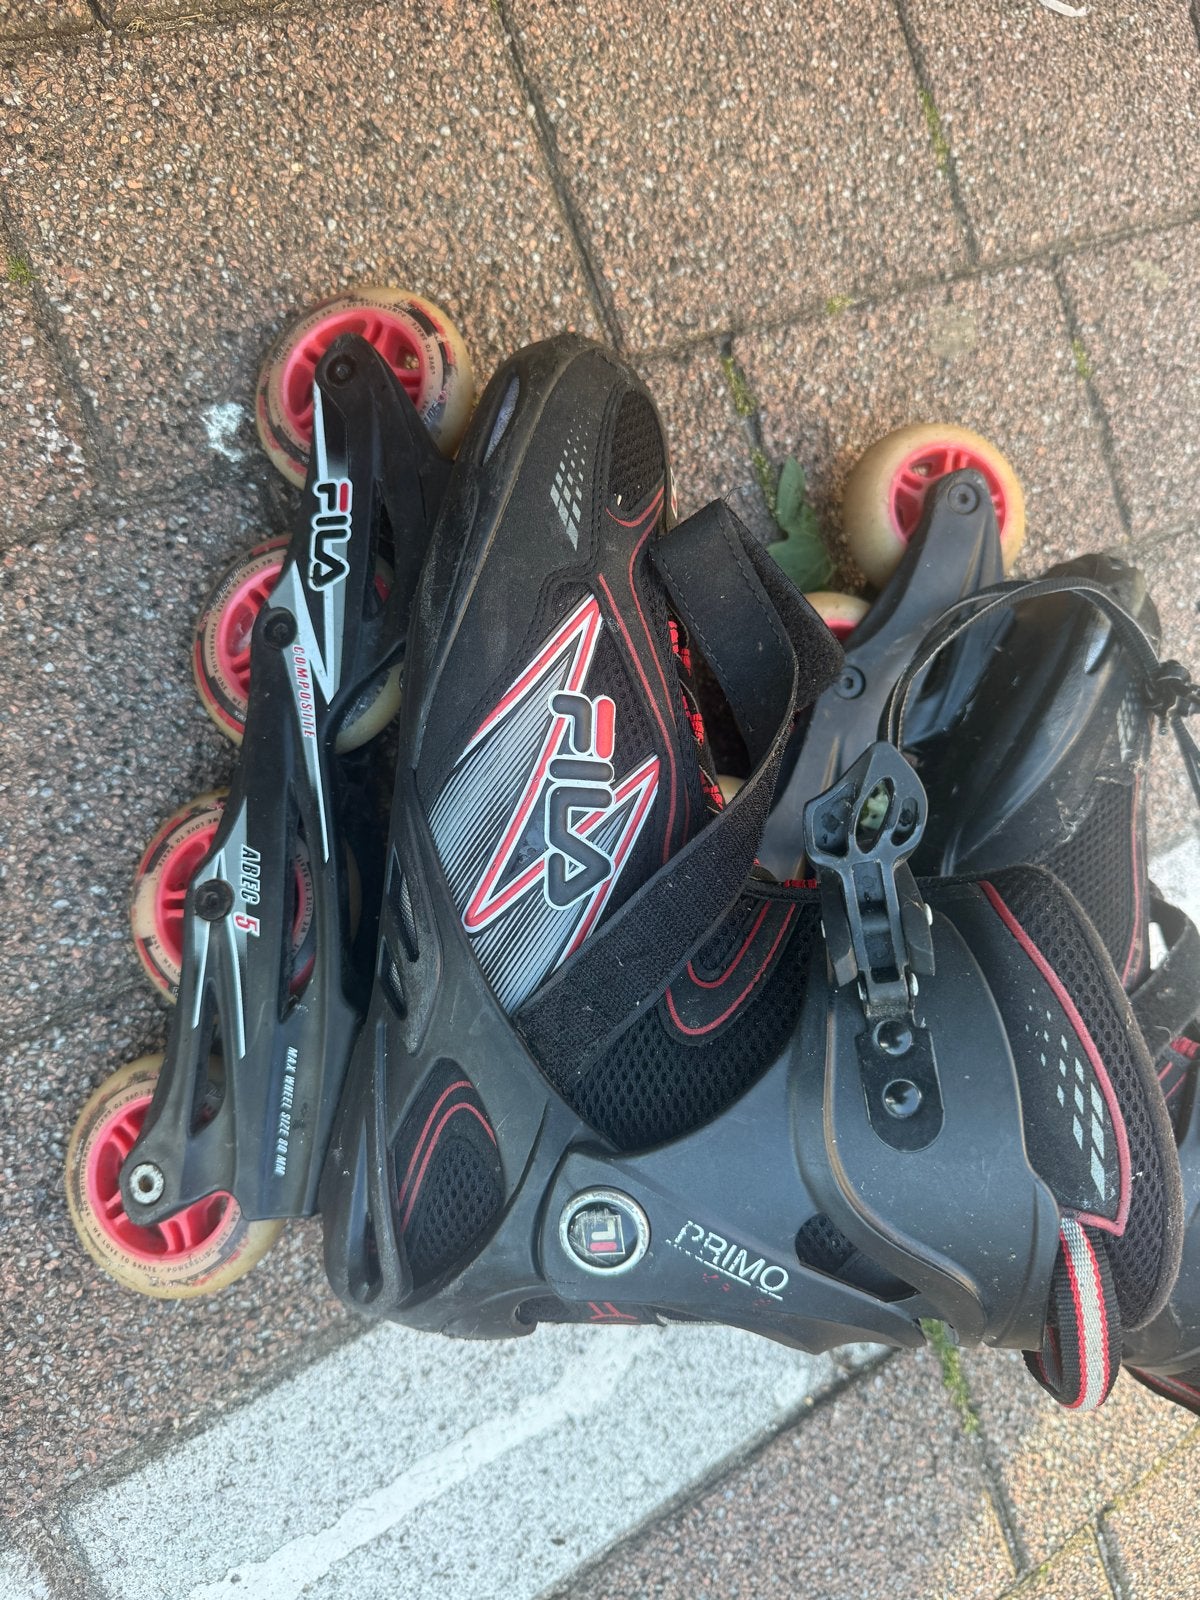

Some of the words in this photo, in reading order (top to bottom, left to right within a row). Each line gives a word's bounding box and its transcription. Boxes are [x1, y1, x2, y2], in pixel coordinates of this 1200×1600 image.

[309, 478, 351, 591] FILA
[210, 622, 219, 673] POWERSLIDE
[293, 645, 316, 737] COMPOSITE
[544, 690, 616, 910] FILA
[240, 844, 261, 905] ABEC
[305, 881, 312, 891] TO
[234, 911, 260, 937] 5
[285, 1046, 298, 1073] MAX
[281, 1074, 295, 1110] WHEEL
[279, 1111, 291, 1138] SIZE
[277, 1137, 288, 1155] 80
[274, 1154, 286, 1177] MM
[102, 1238, 118, 1256] LOVE
[120, 1254, 129, 1264] TO
[132, 1261, 156, 1272] SKATE
[673, 1219, 789, 1293] PRIMO
